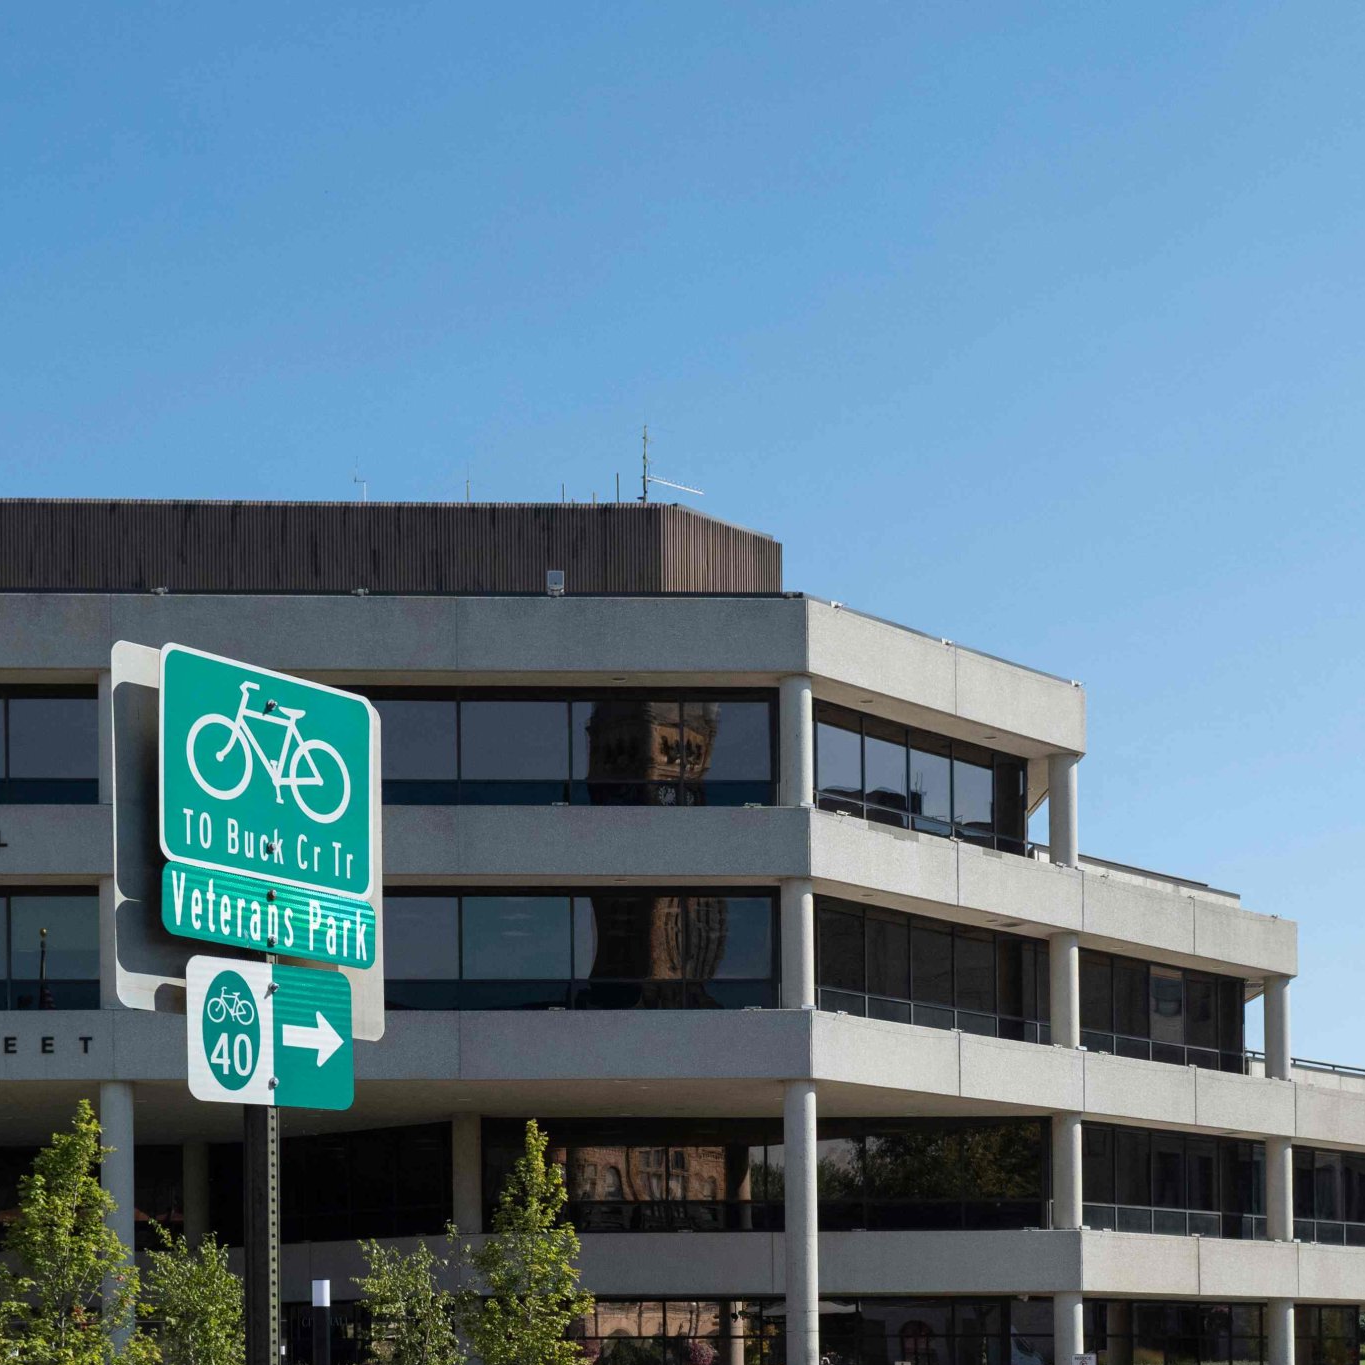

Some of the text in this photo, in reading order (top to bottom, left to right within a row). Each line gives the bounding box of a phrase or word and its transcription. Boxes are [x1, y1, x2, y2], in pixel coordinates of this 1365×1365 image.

[183, 808, 354, 880] TO Buck Cr Tr
[171, 870, 368, 961] Veterans Park
[210, 1032, 253, 1076] 40
